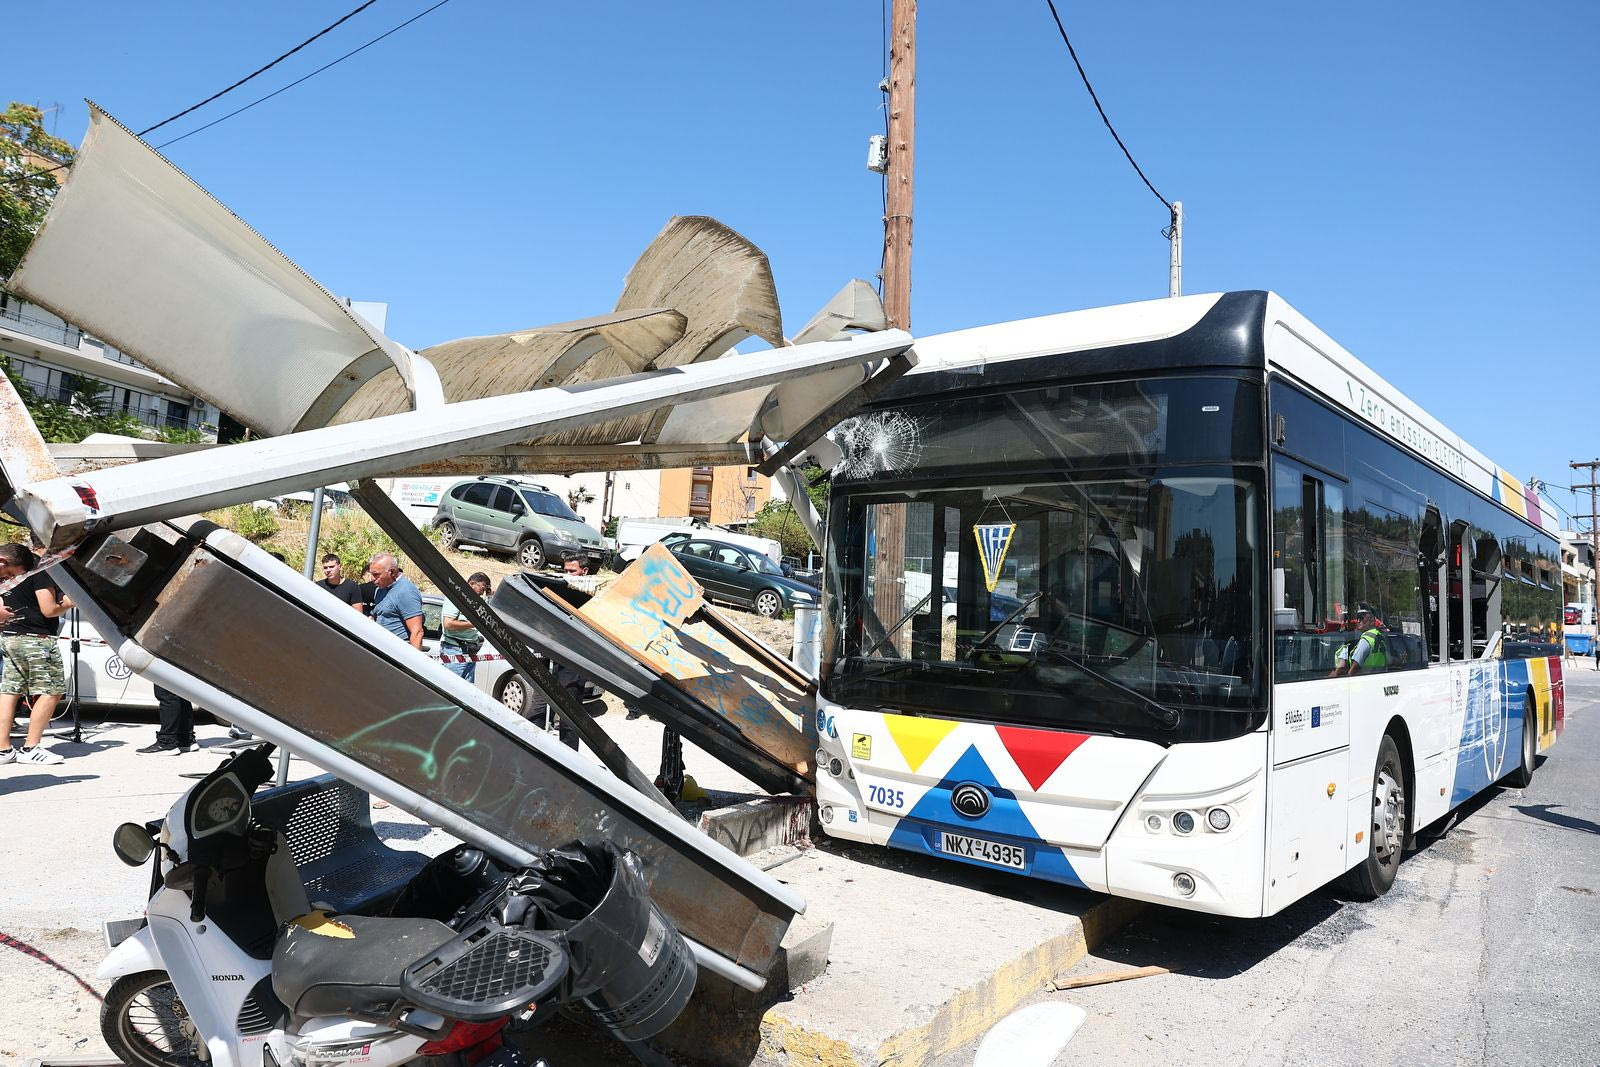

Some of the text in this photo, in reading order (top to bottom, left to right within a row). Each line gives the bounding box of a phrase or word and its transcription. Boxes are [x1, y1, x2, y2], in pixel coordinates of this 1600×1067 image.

[1360, 387, 1468, 480] Zero emission ELECTRIC
[868, 784, 904, 809] 7035
[945, 834, 1022, 866] NKX-4935
